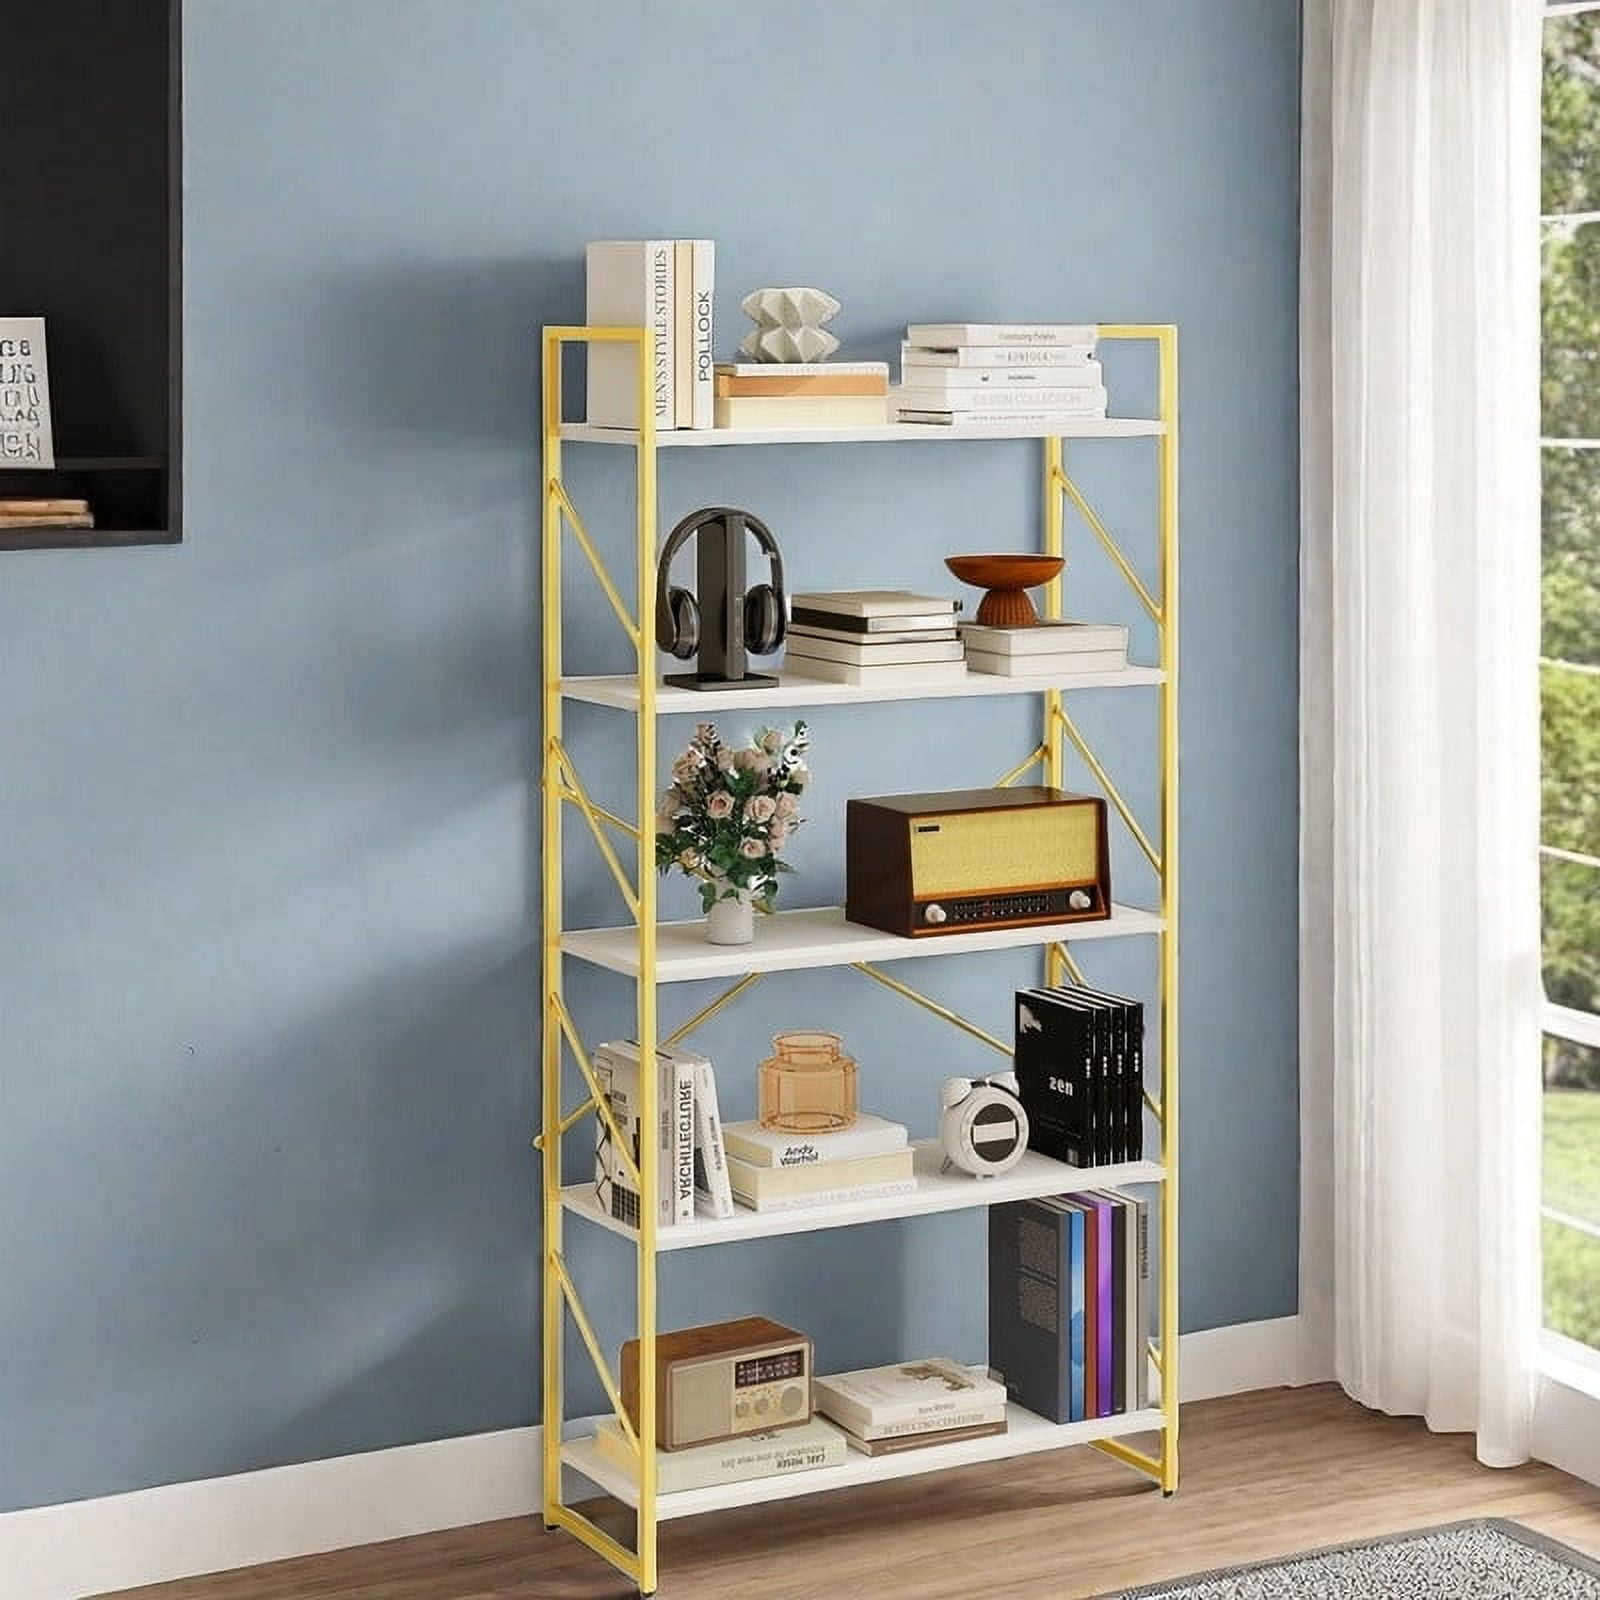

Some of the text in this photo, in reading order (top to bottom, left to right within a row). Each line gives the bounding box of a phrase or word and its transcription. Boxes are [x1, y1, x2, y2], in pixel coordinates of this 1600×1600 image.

[655, 249, 668, 316] STORIES
[655, 318, 668, 367] STYLE
[698, 291, 711, 382] POLLOCK
[1049, 1076, 1073, 1096] zen
[785, 1144, 815, 1156] Andy
